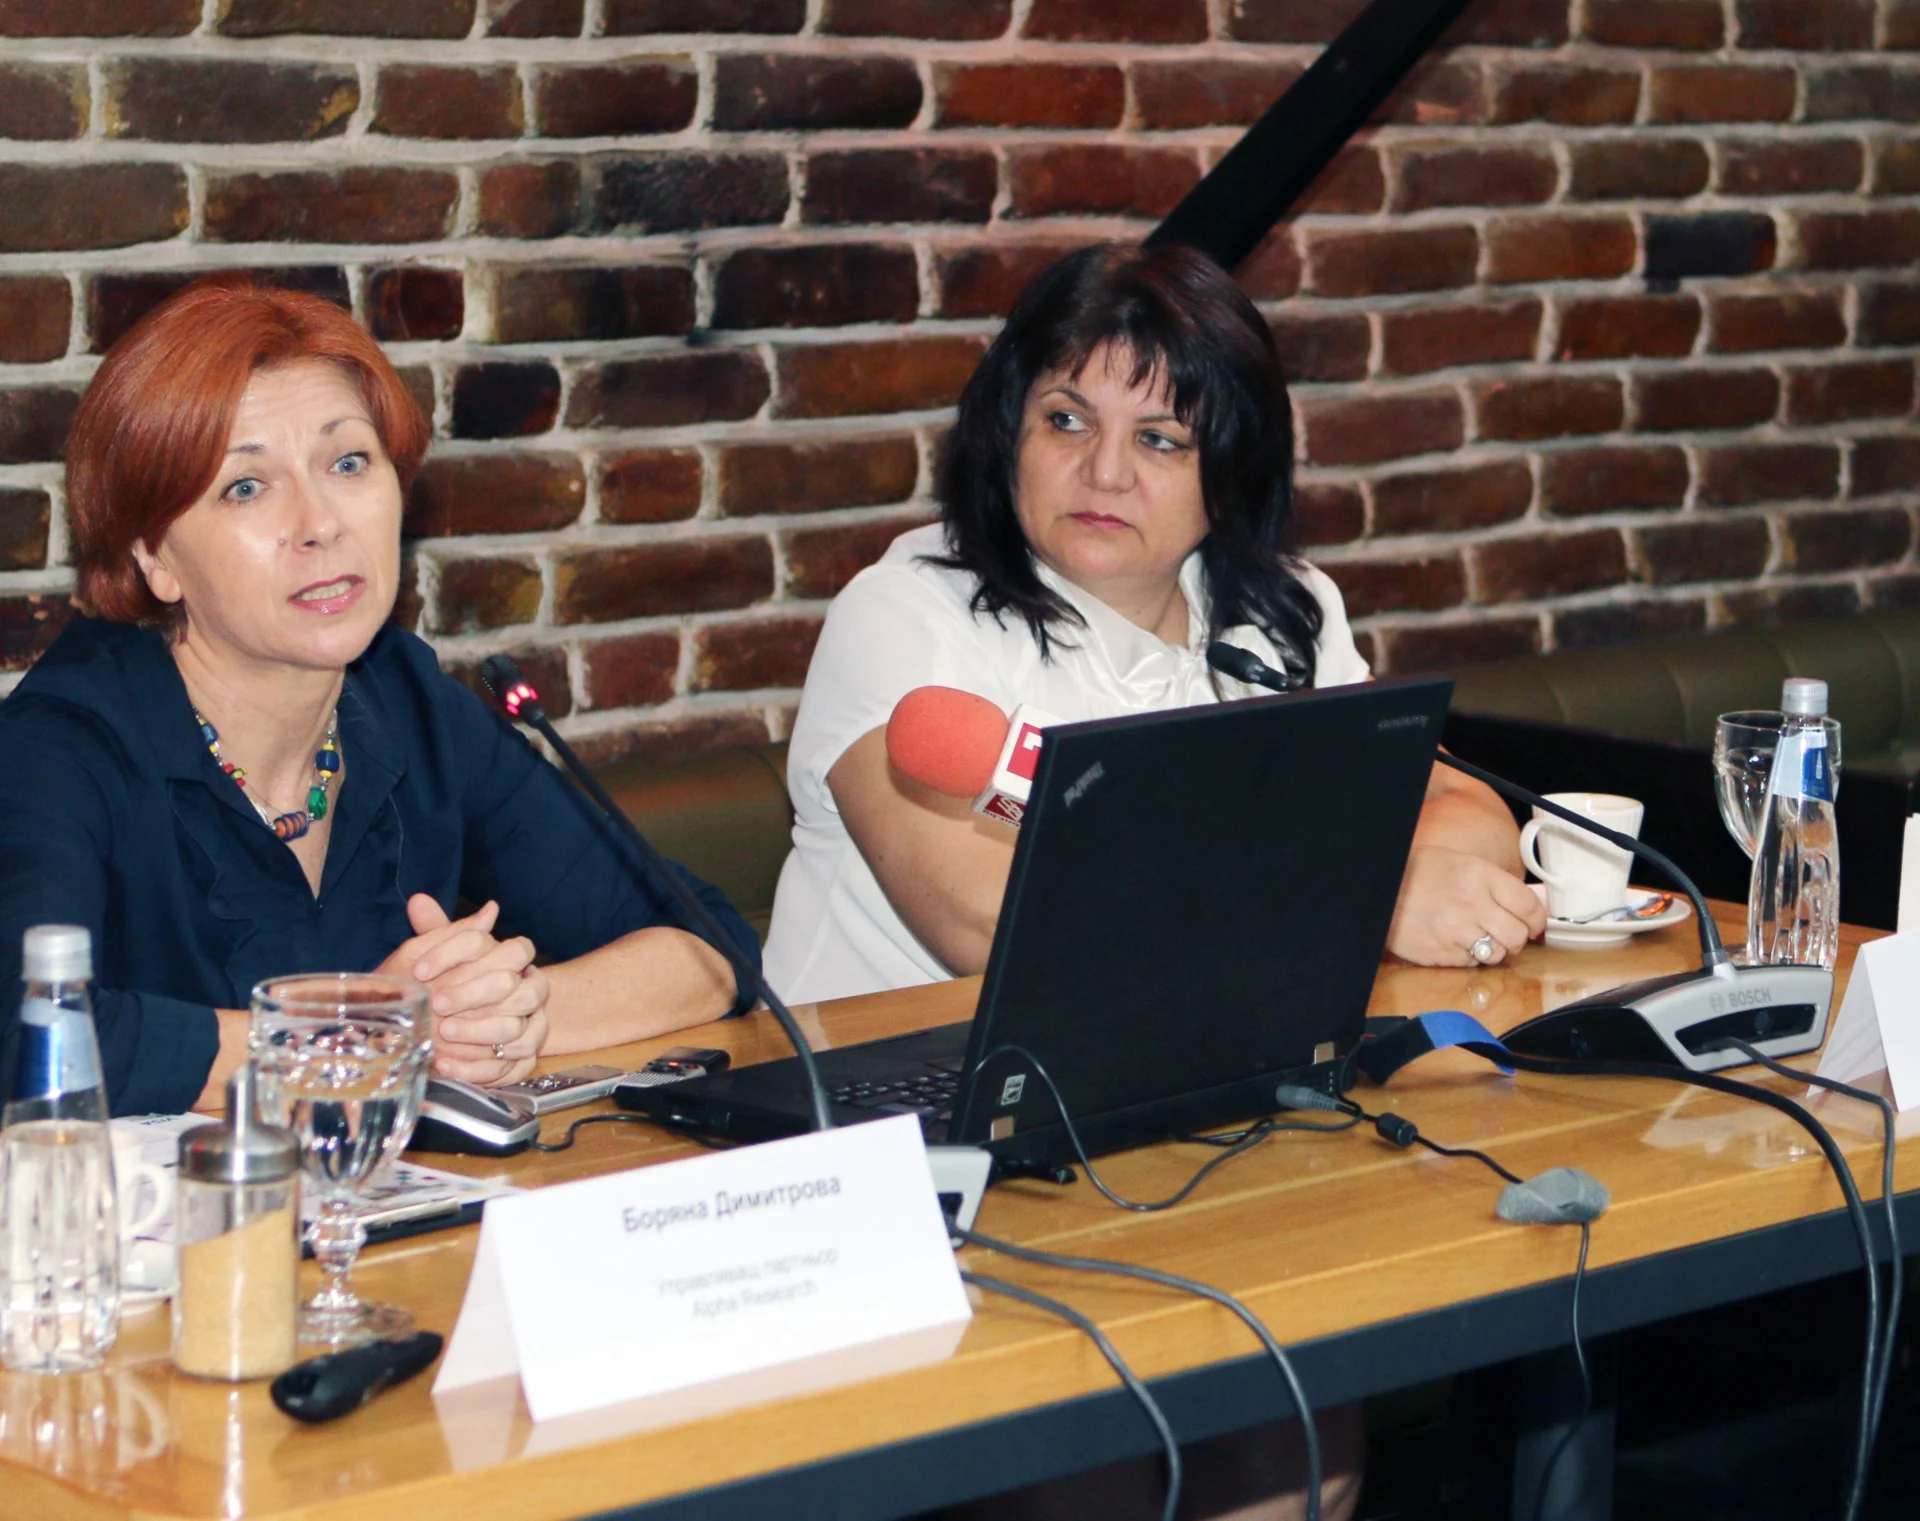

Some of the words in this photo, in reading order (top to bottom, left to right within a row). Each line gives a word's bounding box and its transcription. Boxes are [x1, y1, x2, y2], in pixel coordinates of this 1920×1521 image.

[1728, 988, 1772, 1008] BOSCH
[622, 1201, 709, 1233] Боряна
[715, 1175, 842, 1219] Димитрова
